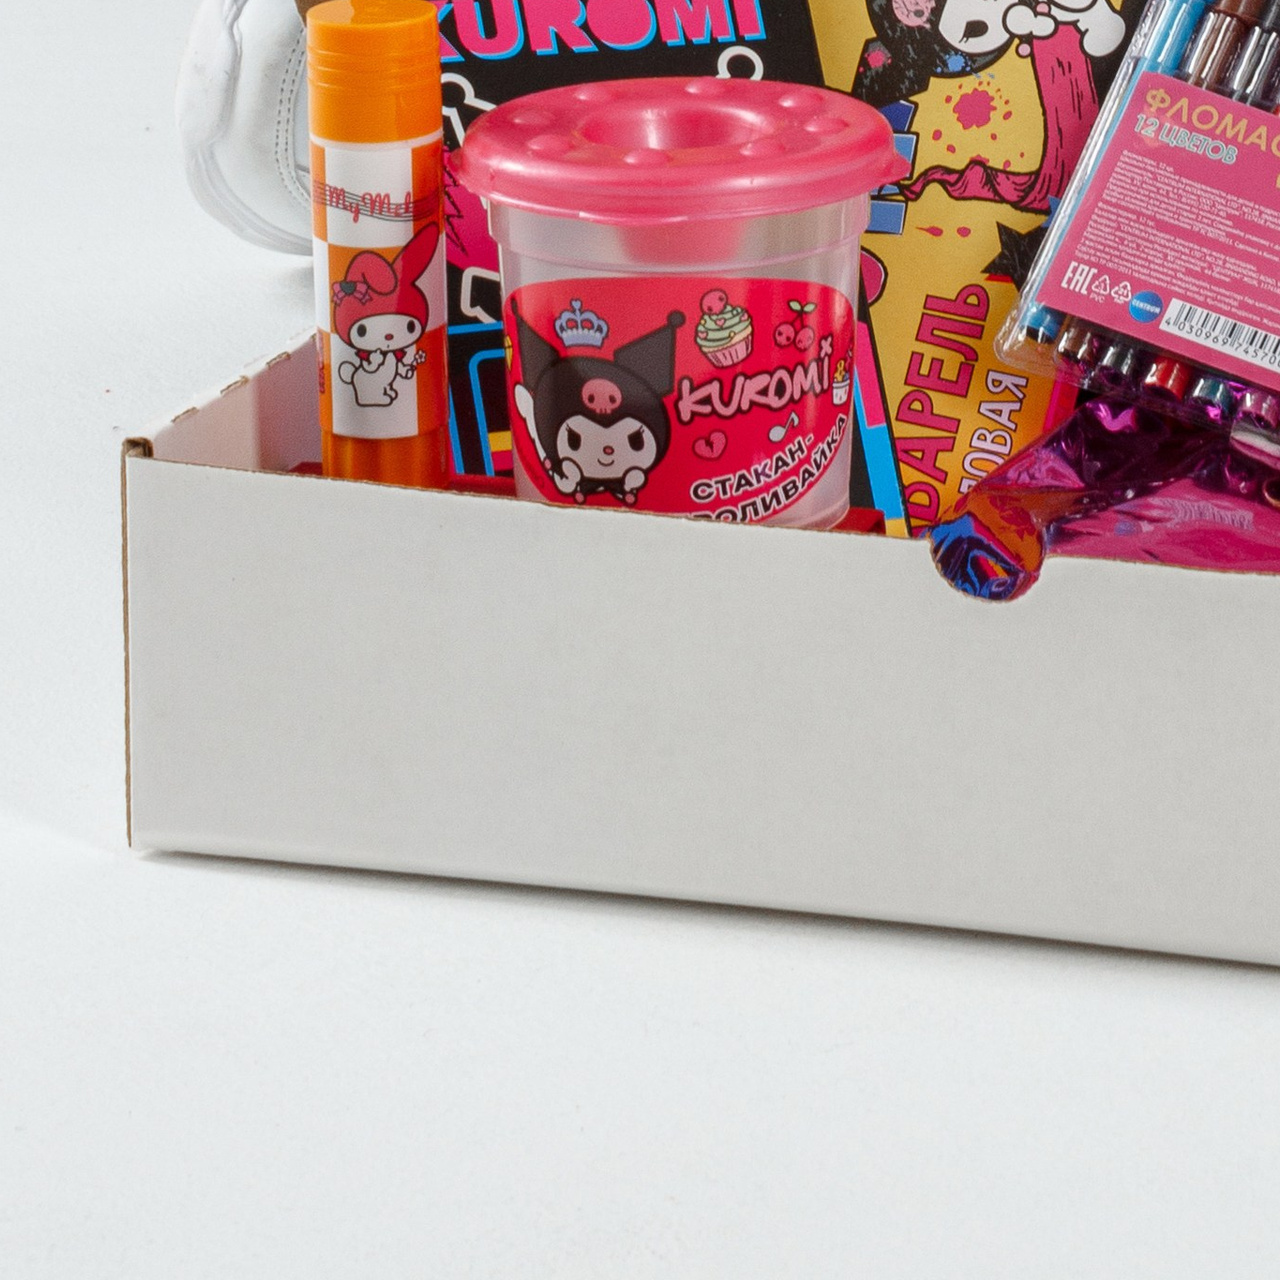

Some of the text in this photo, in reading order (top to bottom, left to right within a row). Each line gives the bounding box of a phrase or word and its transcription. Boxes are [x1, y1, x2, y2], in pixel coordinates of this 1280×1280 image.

[1132, 113, 1240, 165] 12 ЦВЕТОВ
[328, 185, 360, 223] My
[1131, 298, 1160, 314] CENTRUM
[896, 283, 991, 537] ВАРЕЛЬ
[690, 433, 815, 503] СТАКАН-
[691, 412, 849, 524] ОЛИВАЙКА
